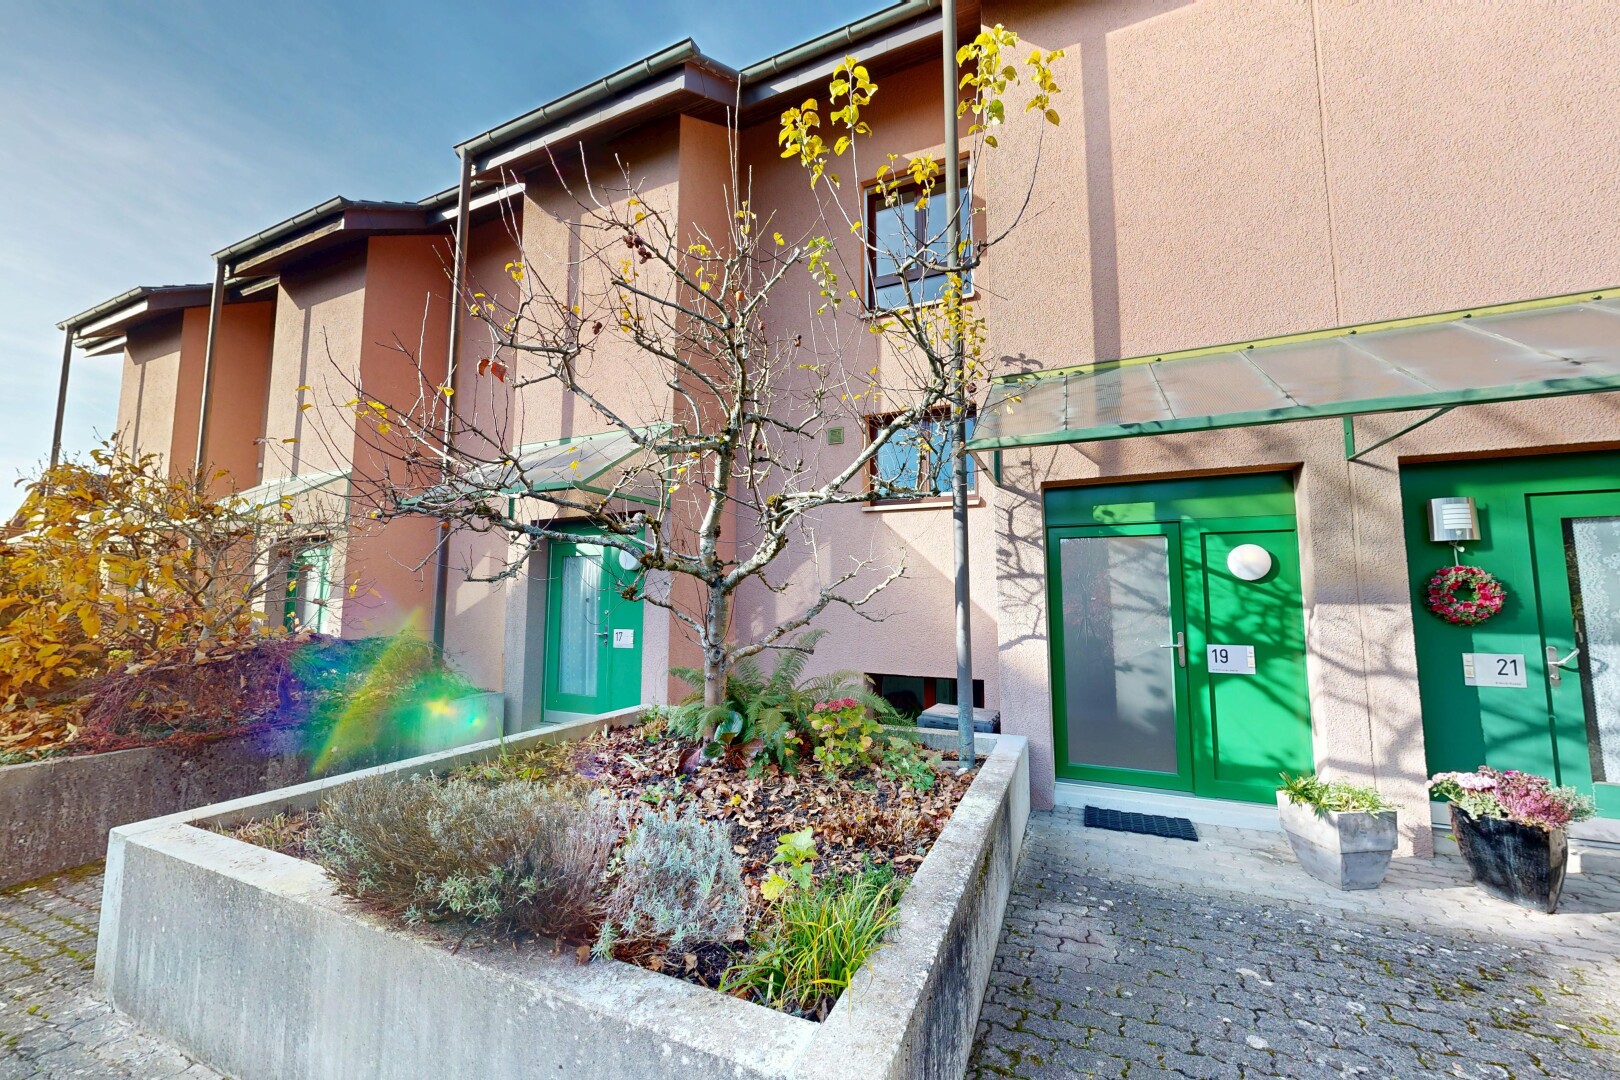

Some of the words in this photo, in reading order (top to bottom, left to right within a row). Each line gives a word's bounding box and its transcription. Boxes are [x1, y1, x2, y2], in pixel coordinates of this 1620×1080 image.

[615, 631, 623, 642] 17
[1211, 648, 1229, 664] 19
[1496, 658, 1518, 676] 21
